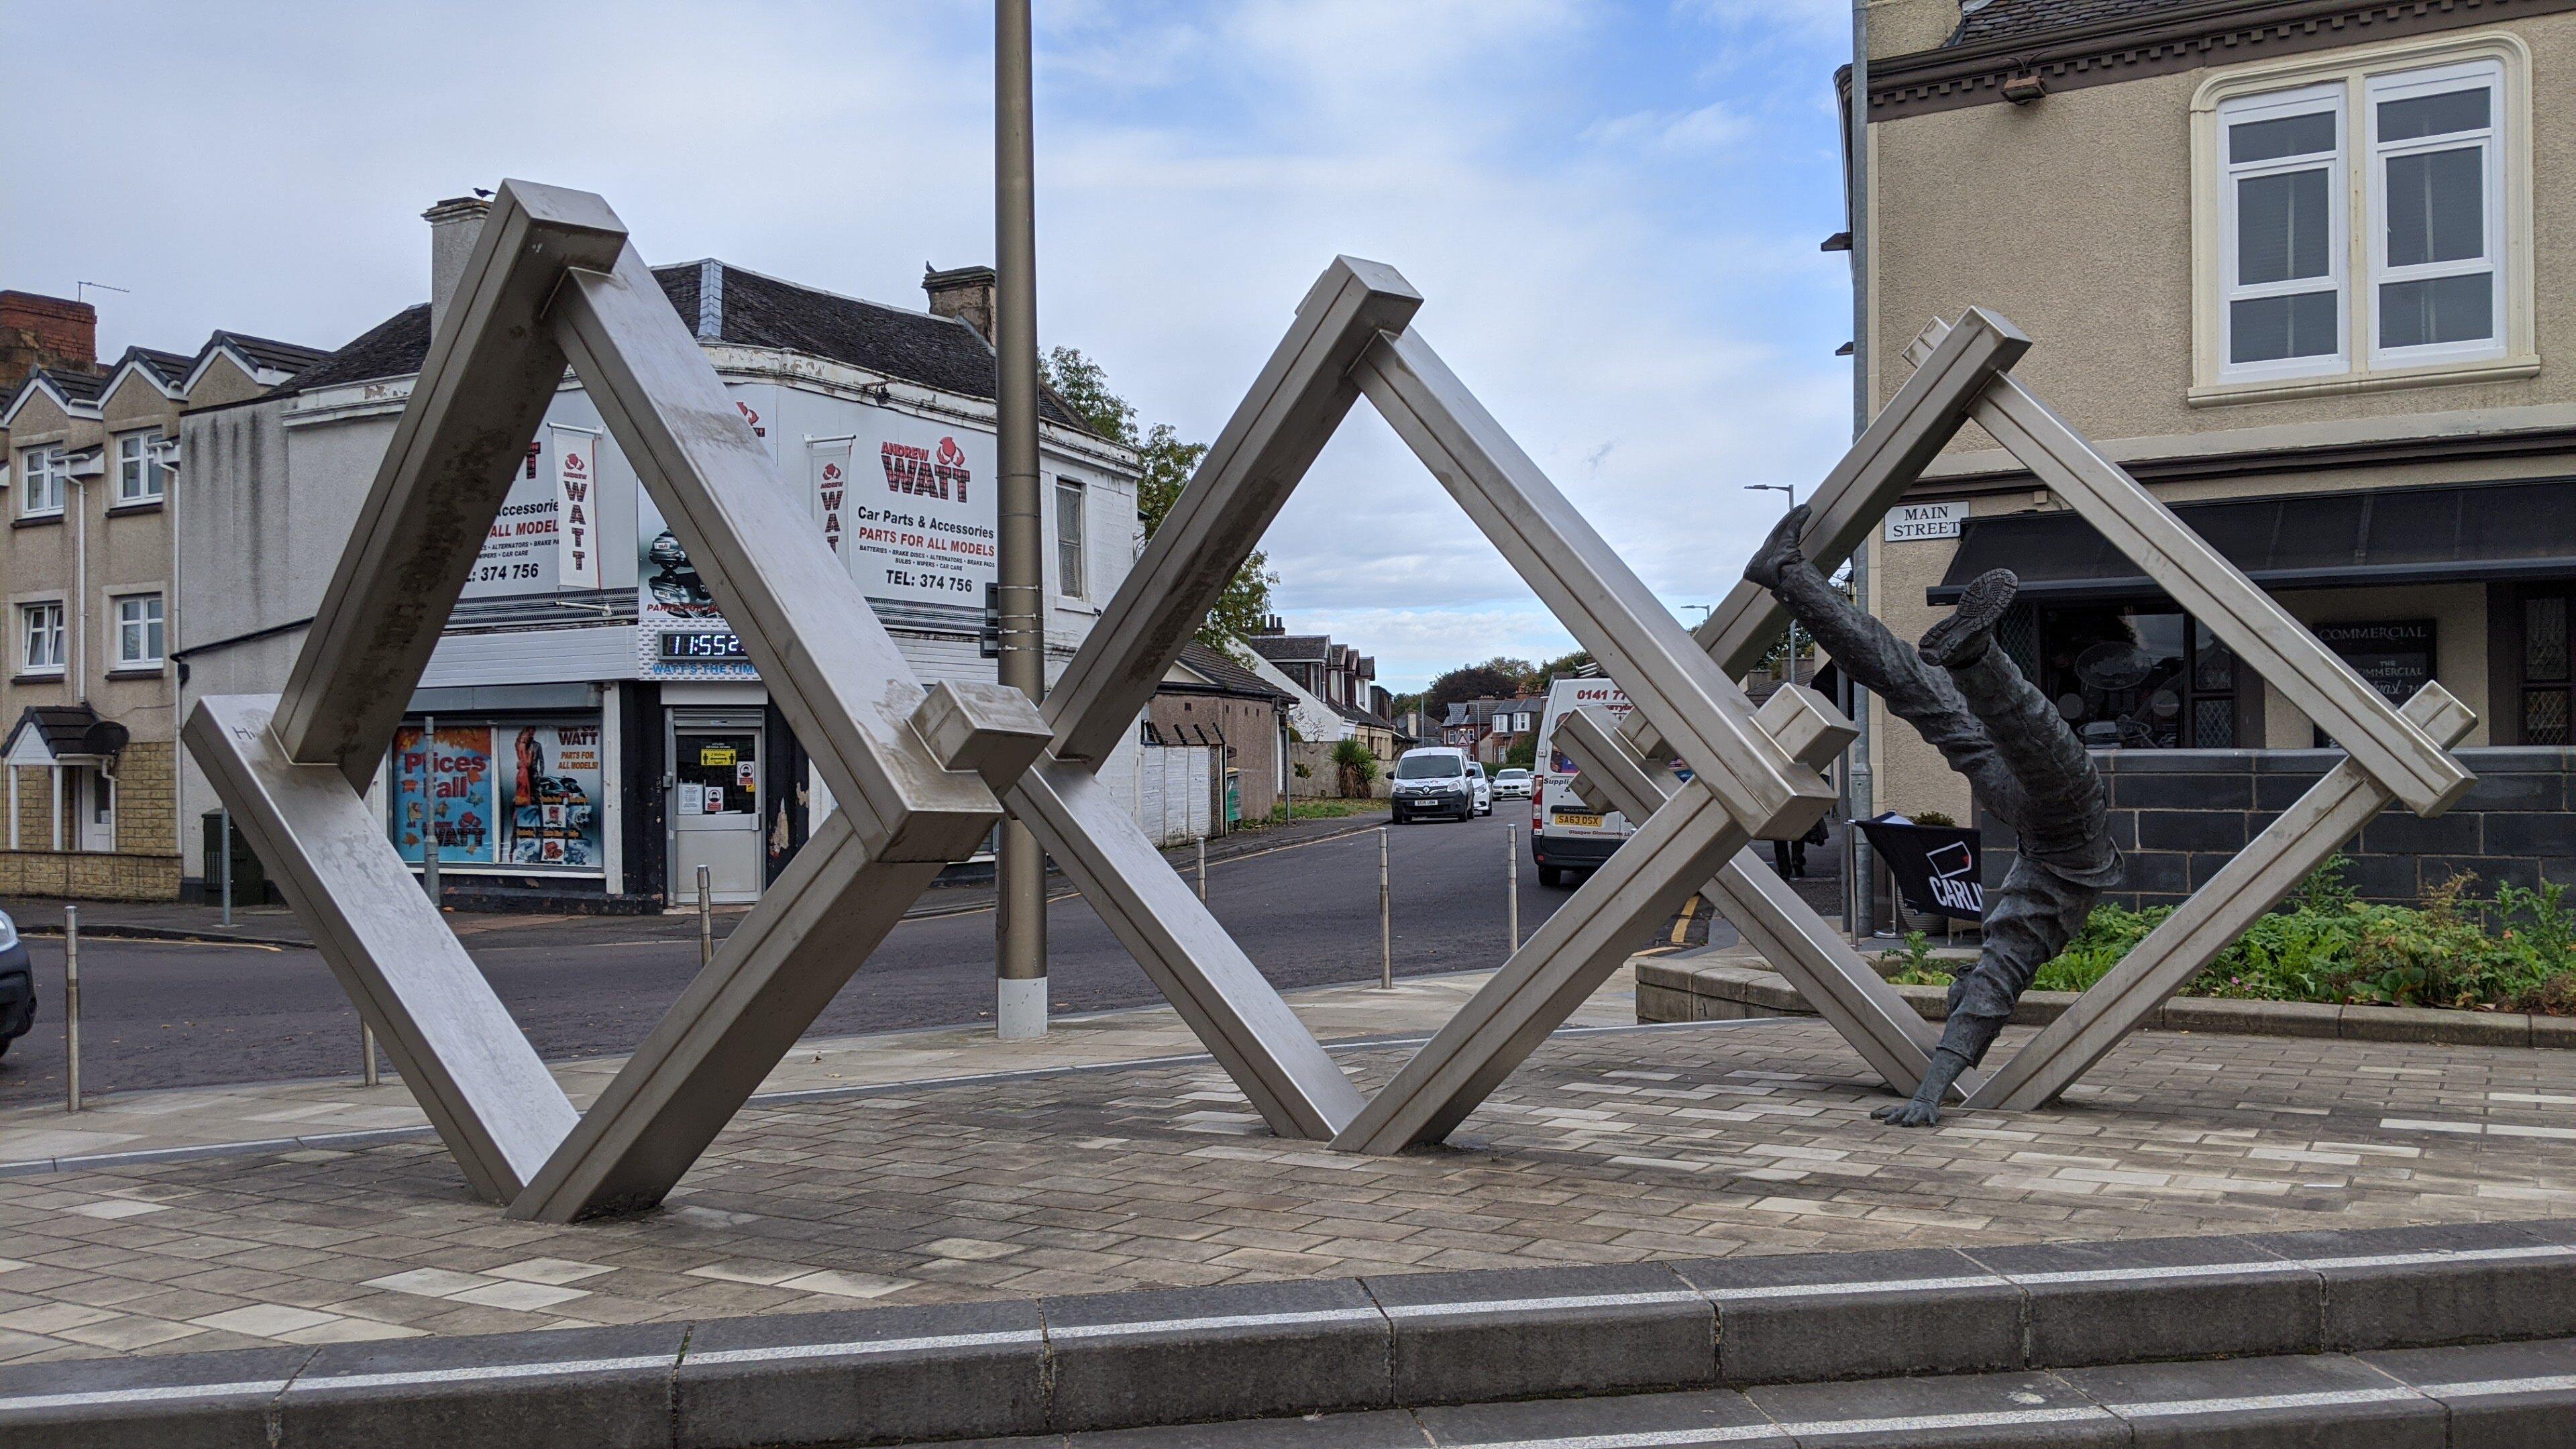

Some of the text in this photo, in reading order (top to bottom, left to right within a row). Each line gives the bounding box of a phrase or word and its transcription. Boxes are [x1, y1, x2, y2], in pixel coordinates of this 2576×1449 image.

[881, 441, 930, 462] ANDREW
[564, 472, 588, 480] ANDREW
[881, 455, 971, 503] WATT
[820, 481, 843, 489] ANDREW
[496, 499, 559, 517] ccessorie
[1904, 506, 1949, 521] MAIN
[490, 520, 559, 537] ALL MODEL
[564, 481, 588, 571] WATT
[820, 490, 843, 554] WAT
[858, 506, 994, 539] Car Parts & Accessories
[1893, 521, 1961, 537] STREET
[492, 541, 529, 550] ALTERNATORS
[859, 527, 995, 557] PARTS FOR ALL MODELS
[859, 545, 888, 554] BATTERIES
[930, 555, 963, 564] ALTERNATORS
[967, 559, 983, 567] BRAKE
[916, 560, 935, 568] WIPERS
[480, 566, 506, 582] 374
[513, 563, 539, 580] 756
[886, 569, 973, 592] TEL: 374 756
[2319, 626, 2427, 641] COMMERCIAL
[653, 664, 757, 673] WATT'S THE TIM
[2361, 667, 2422, 677] MMERCIAL
[1577, 690, 1627, 700] 0141 77
[557, 732, 598, 745] WATT
[561, 751, 594, 759] PARTS FOR
[557, 761, 570, 769] ALL
[1544, 777, 1569, 786] Suppli
[1558, 815, 1580, 824] SA63
